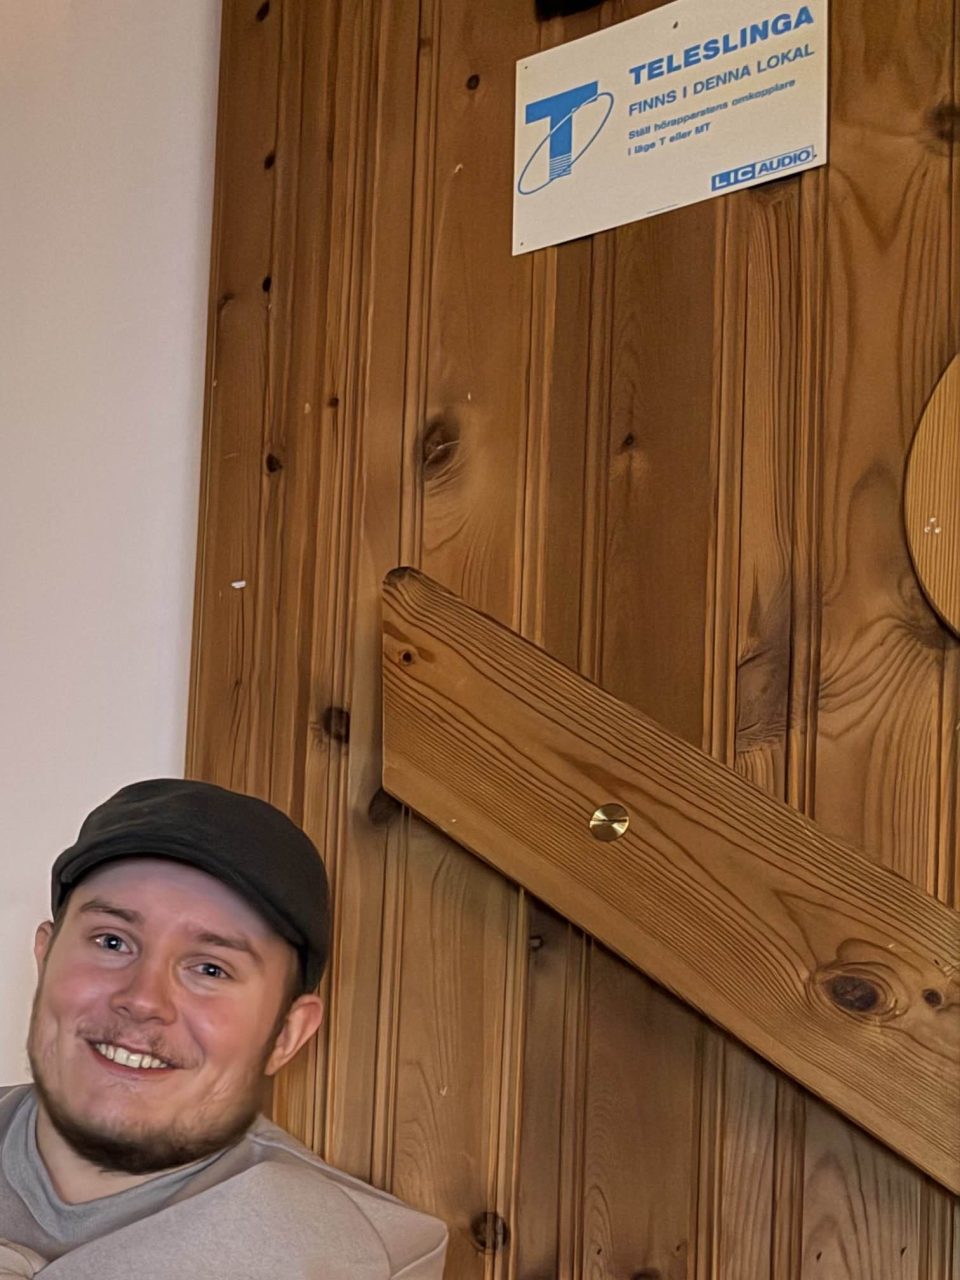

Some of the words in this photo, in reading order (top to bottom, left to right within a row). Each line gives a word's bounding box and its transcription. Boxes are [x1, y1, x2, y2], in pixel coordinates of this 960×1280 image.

[628, 5, 814, 85] TELESLINGA
[628, 90, 677, 116] FINNS
[682, 86, 688, 99] I
[693, 62, 751, 96] DENNA
[756, 43, 815, 75] LOKAL
[731, 79, 796, 106] omkopplare
[659, 136, 666, 146] T
[669, 130, 692, 143] eller
[695, 122, 711, 134] MT
[714, 167, 755, 188] LIC
[757, 148, 811, 176] AUDIO
